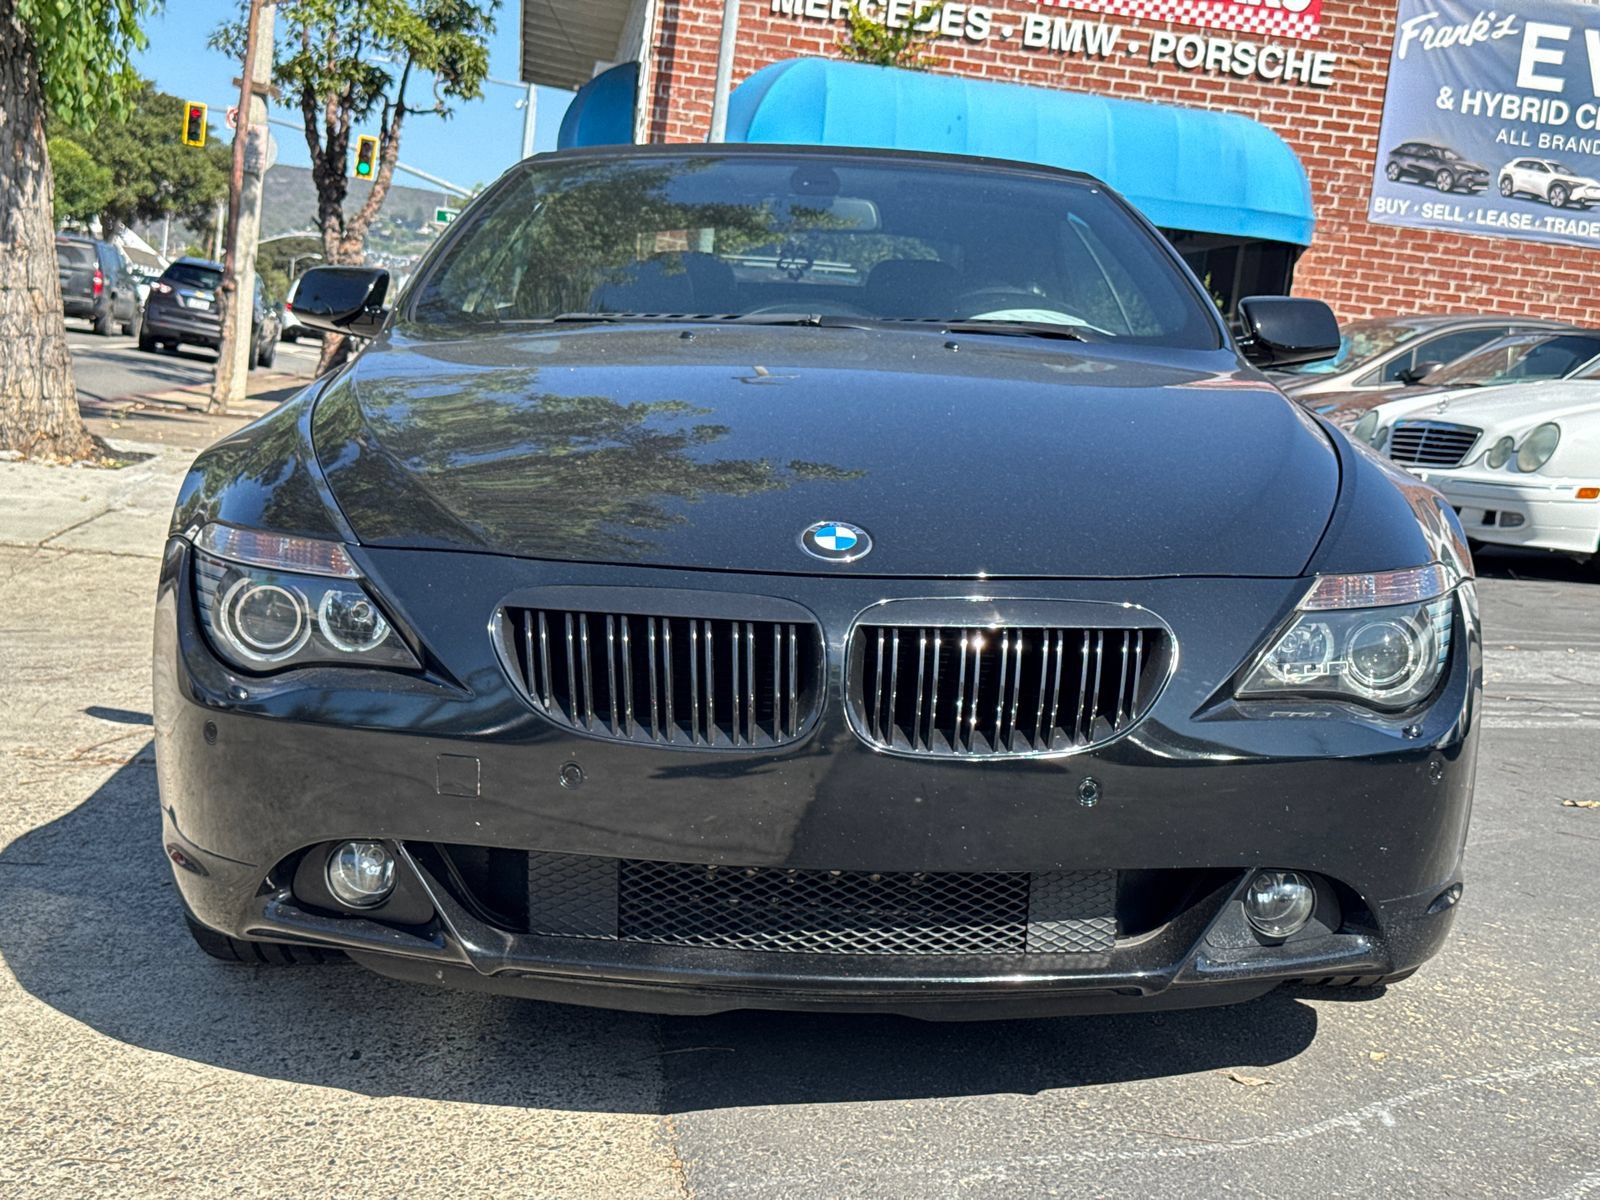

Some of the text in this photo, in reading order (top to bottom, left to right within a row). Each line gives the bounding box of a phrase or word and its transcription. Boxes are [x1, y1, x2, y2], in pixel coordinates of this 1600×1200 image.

[1024, 13, 1121, 57] BMW
[1150, 31, 1337, 86] PORSCHE
[1398, 11, 1519, 60] Frank's
[1516, 21, 1600, 98] E
[1436, 86, 1600, 131] & HYBRID C
[1496, 128, 1531, 147] ALL
[1374, 197, 1600, 238] BUY SELL LEASE TRADE
